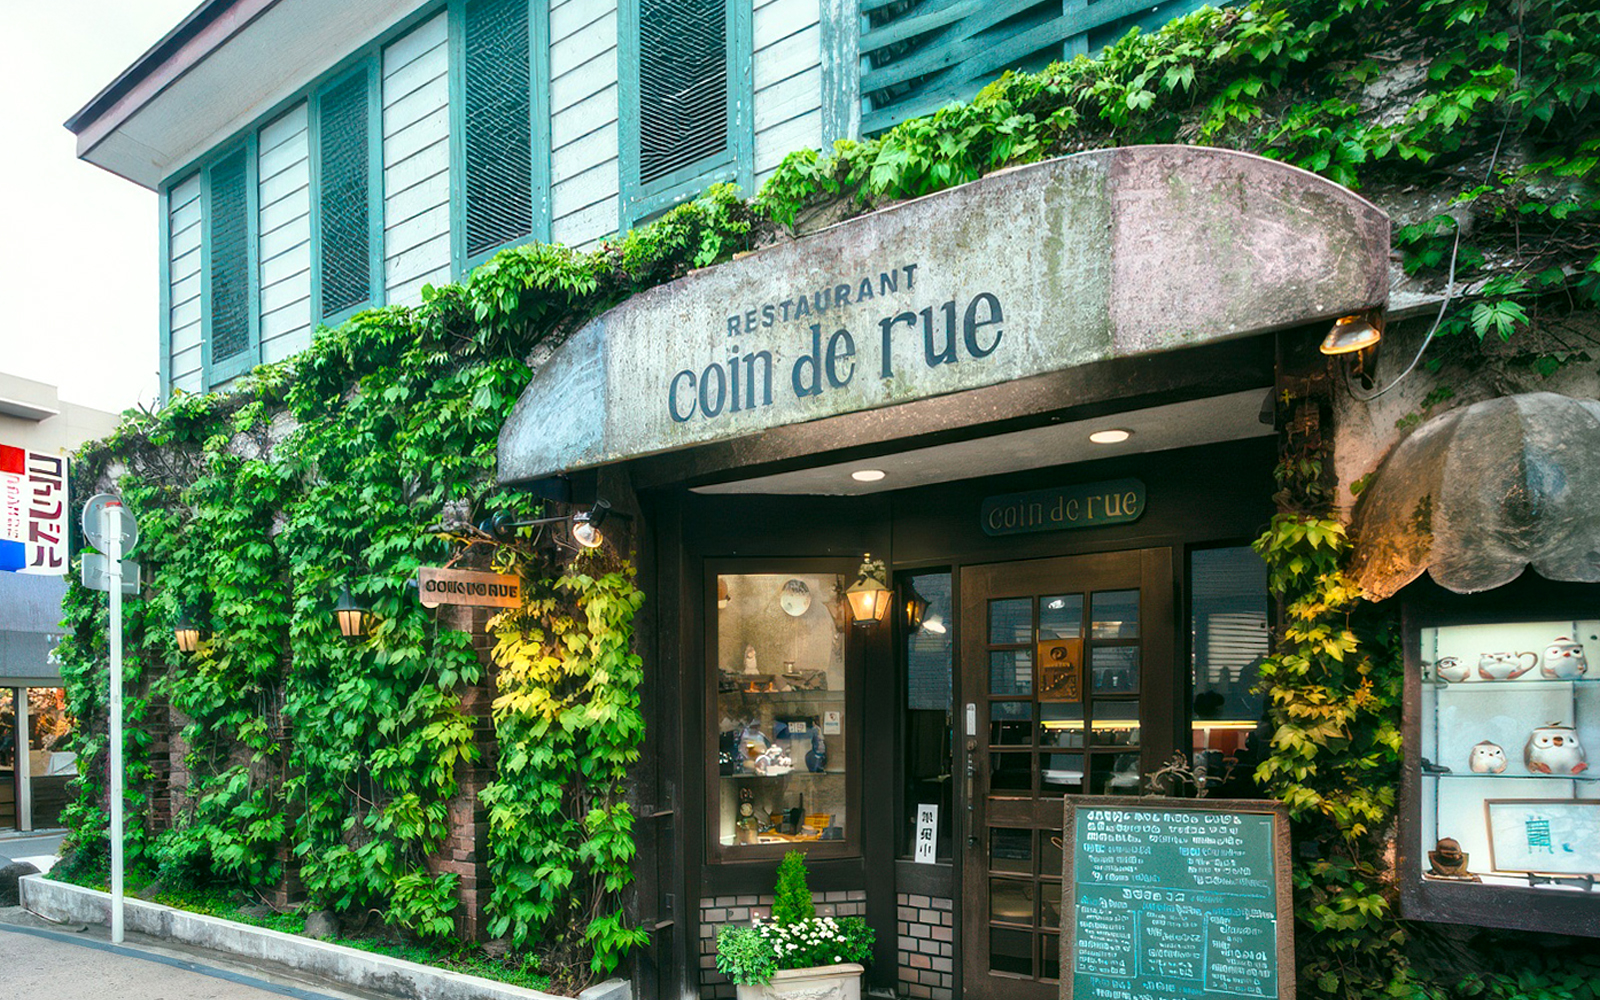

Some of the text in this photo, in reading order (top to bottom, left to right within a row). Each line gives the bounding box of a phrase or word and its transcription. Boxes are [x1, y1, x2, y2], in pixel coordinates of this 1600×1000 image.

[727, 264, 918, 337] RESTAURANT
[668, 292, 1003, 423] coin de rue
[988, 500, 1042, 529] coin
[1087, 491, 1137, 519] rue
